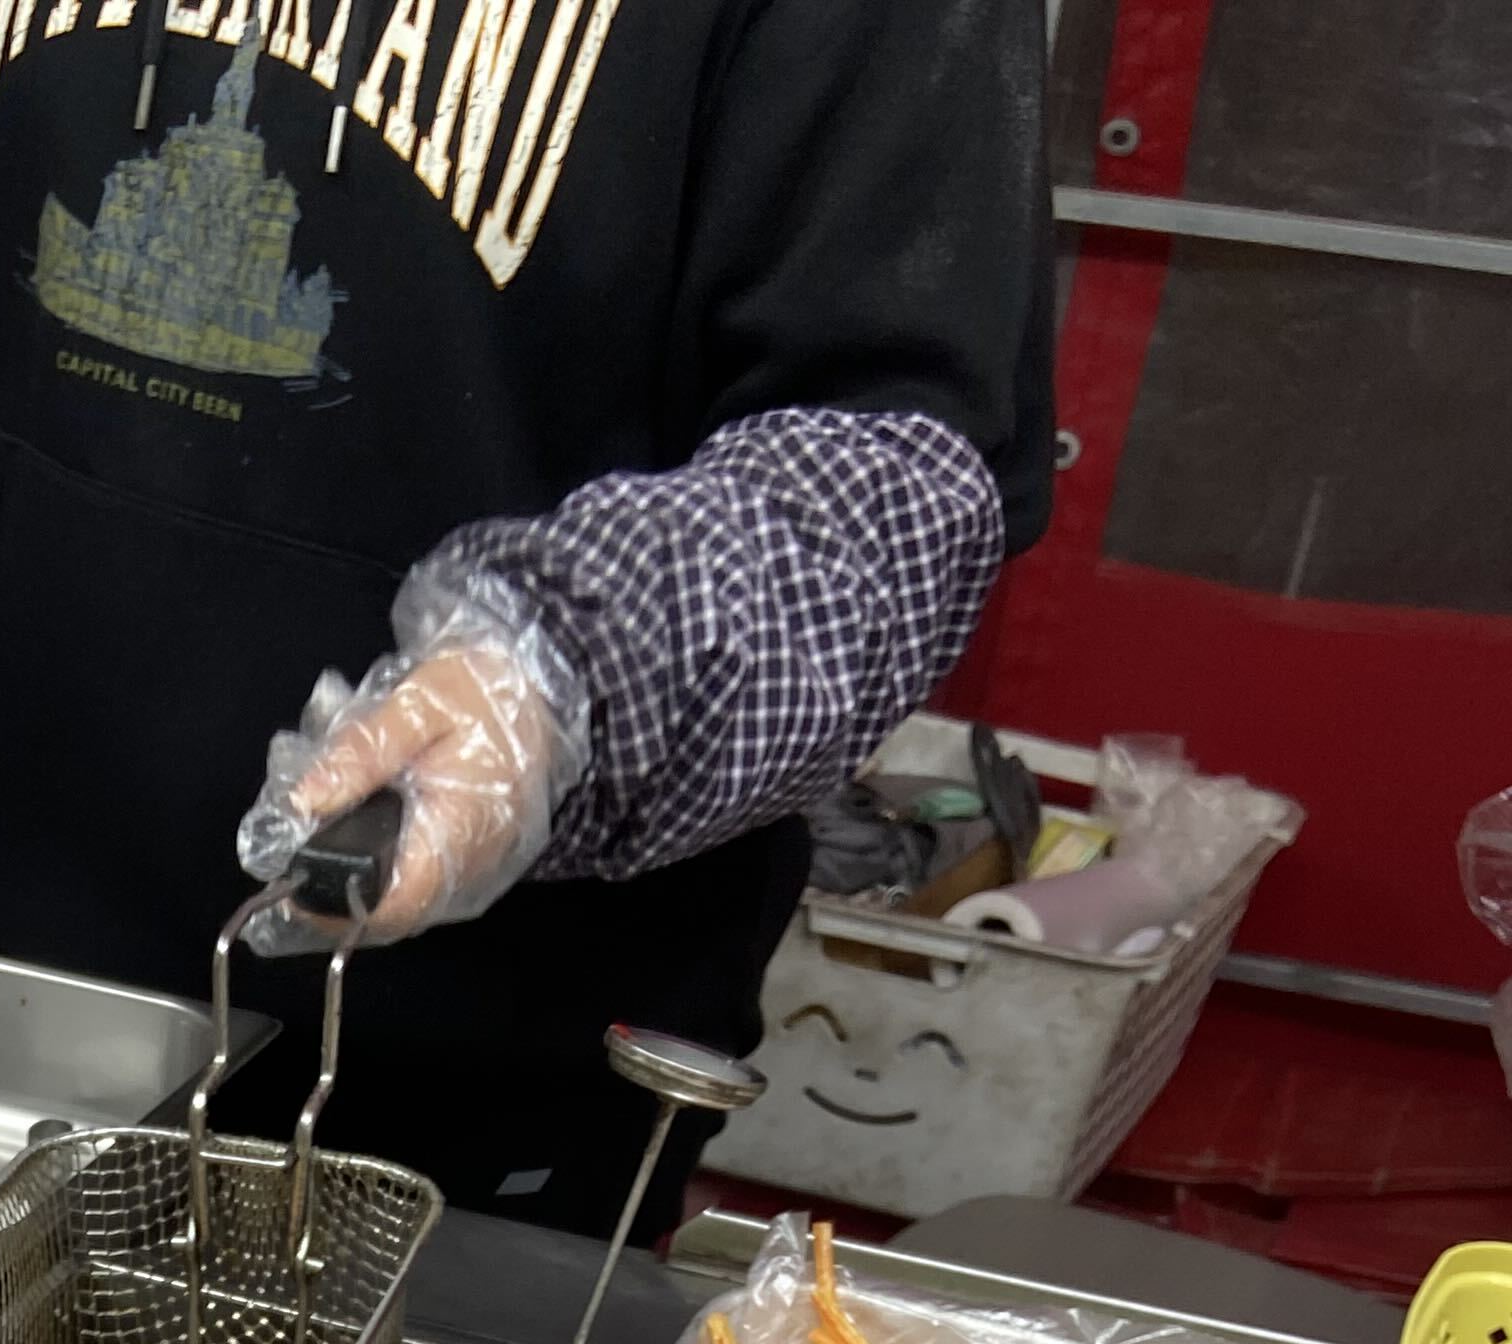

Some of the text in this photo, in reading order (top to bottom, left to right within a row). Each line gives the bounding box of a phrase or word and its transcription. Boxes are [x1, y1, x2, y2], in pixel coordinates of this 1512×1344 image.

[56, 351, 244, 423] CAPITAL CITY BERN
